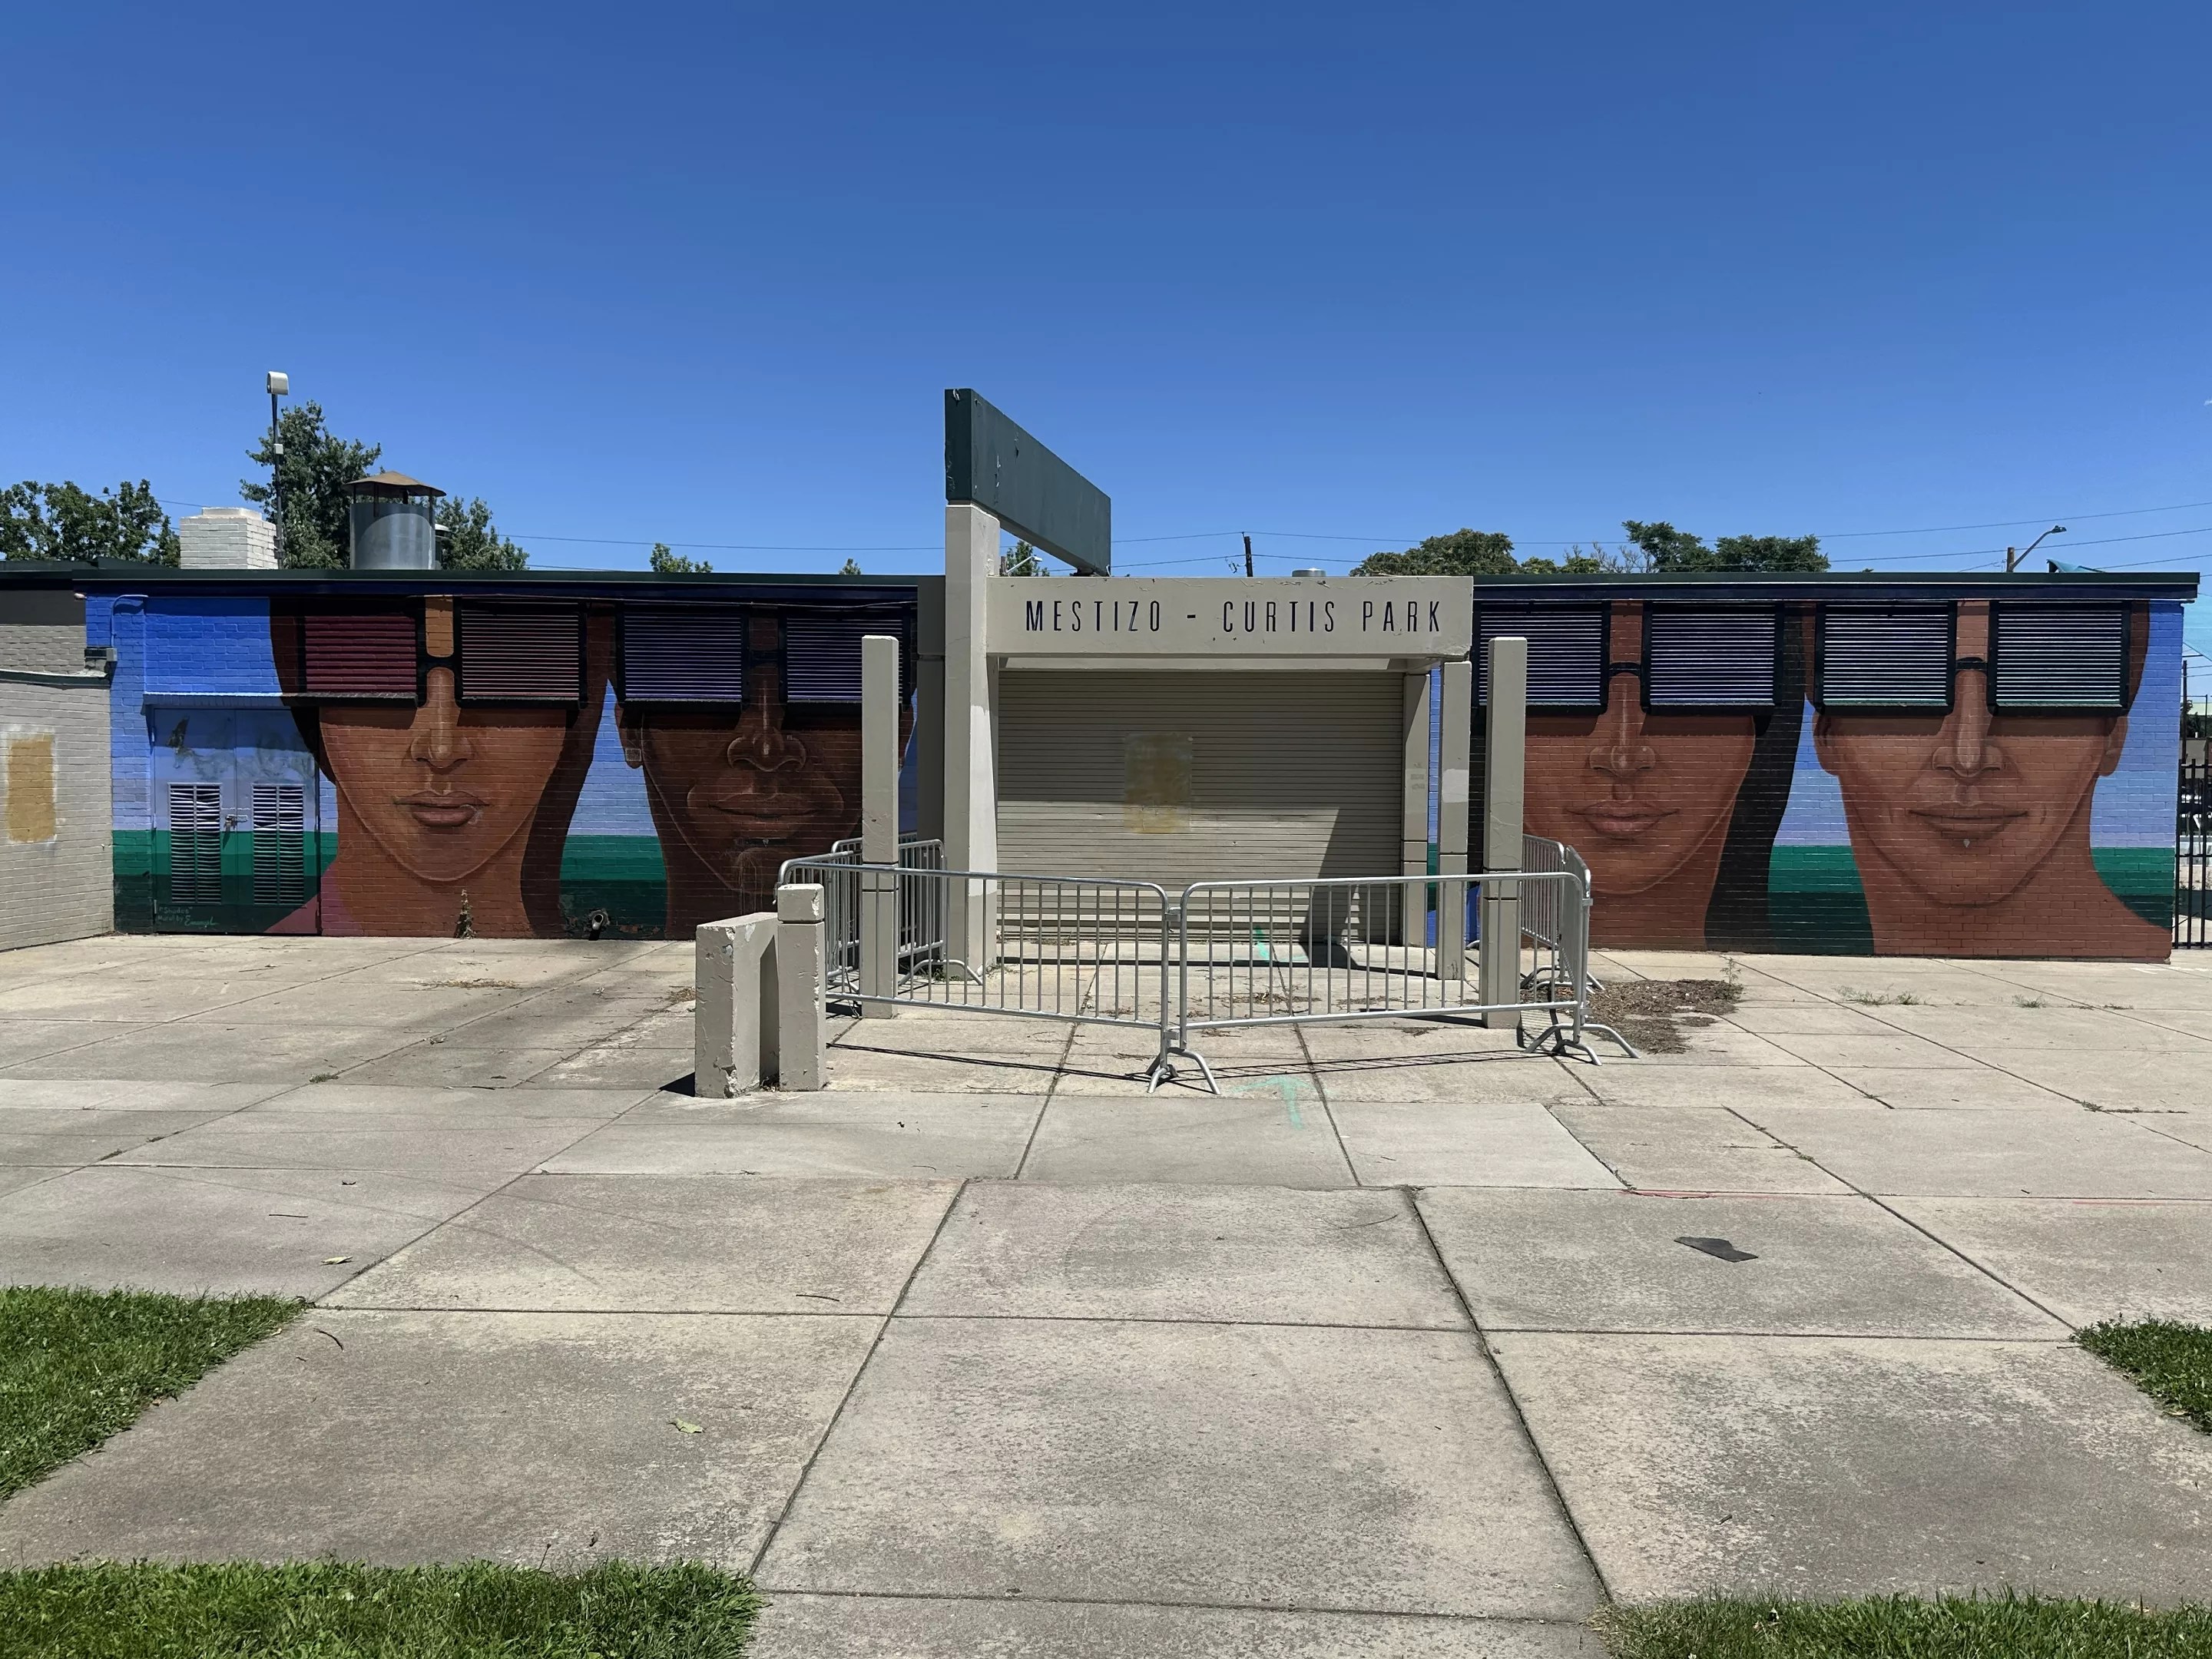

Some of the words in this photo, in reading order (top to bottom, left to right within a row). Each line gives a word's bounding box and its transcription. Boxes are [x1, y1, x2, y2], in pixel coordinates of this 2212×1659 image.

[1026, 601, 1160, 632] MESTIZO
[1223, 601, 1335, 633] CURTIS
[1363, 601, 1439, 632] PARK
